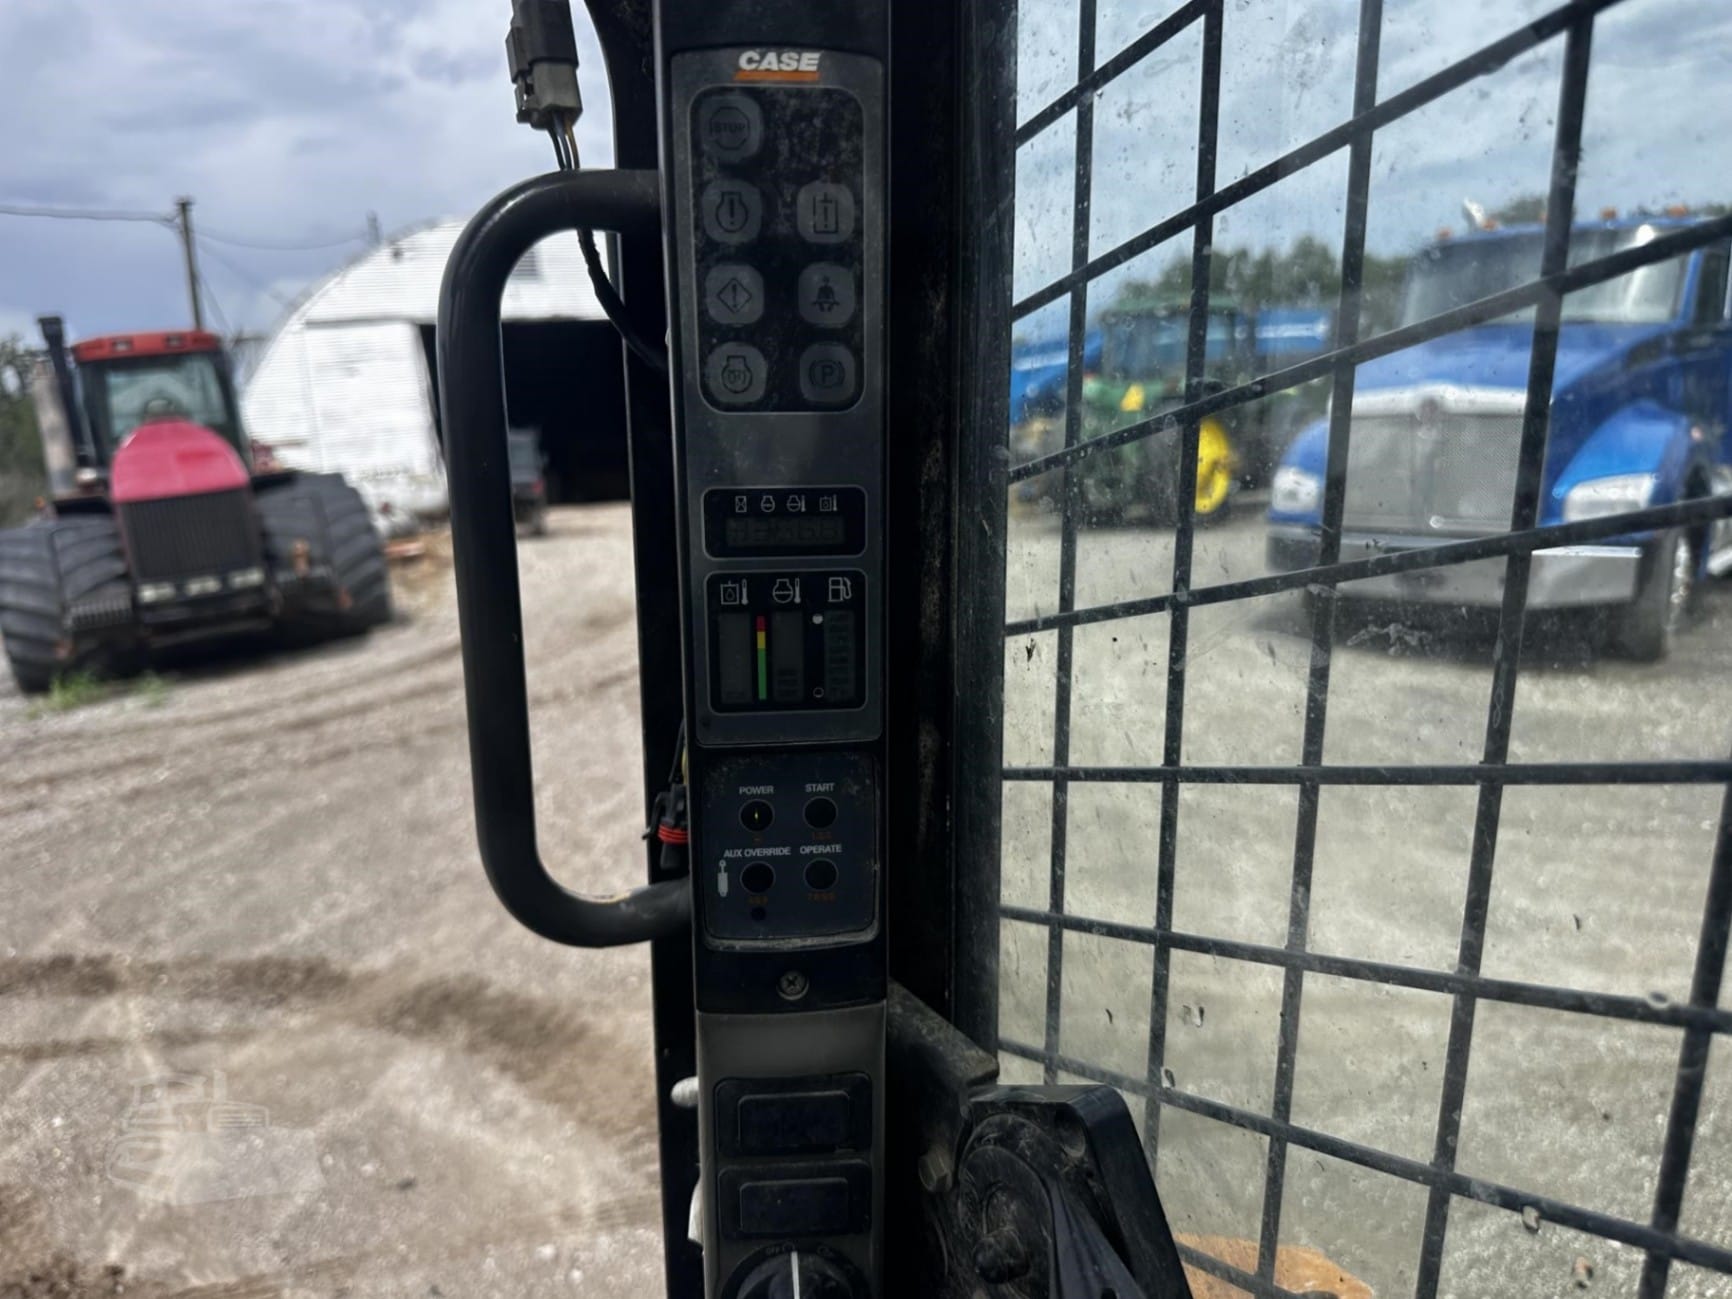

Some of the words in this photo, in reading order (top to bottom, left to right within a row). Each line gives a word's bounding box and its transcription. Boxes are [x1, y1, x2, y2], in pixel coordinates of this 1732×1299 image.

[738, 51, 822, 72] CASE
[821, 364, 834, 384] P
[738, 785, 775, 795] POWER
[805, 782, 835, 793] START
[723, 848, 743, 858] AUX
[744, 846, 792, 857] OVERRIDE
[799, 844, 843, 855] OPERATE
